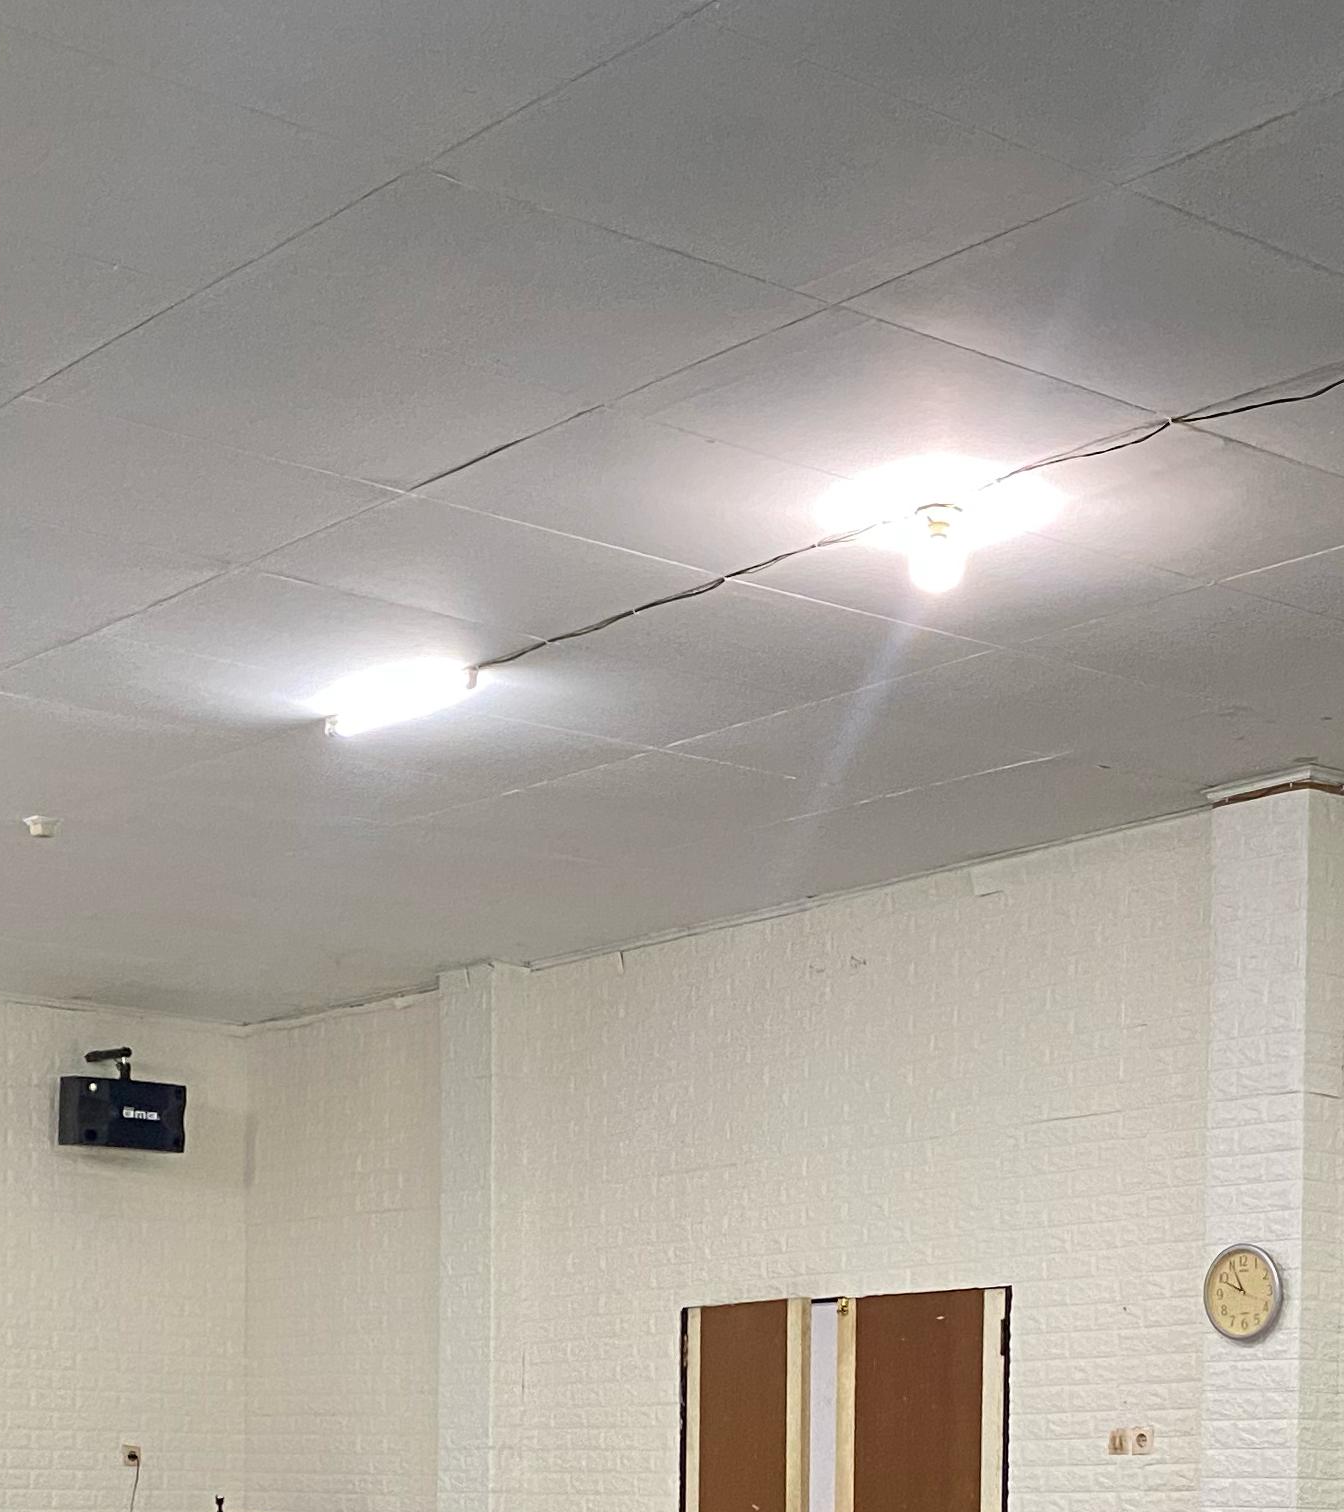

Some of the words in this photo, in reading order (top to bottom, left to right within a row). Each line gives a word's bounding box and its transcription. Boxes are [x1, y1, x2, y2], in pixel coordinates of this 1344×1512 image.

[1239, 1255, 1248, 1267] 12
[1262, 1268, 1269, 1280] 2
[1216, 1288, 1224, 1300] 9
[1266, 1284, 1273, 1296] 3
[1221, 1304, 1228, 1316] 8
[1230, 1315, 1236, 1327] 7
[1241, 1318, 1248, 1330] 6
[1254, 1313, 1260, 1325] 5
